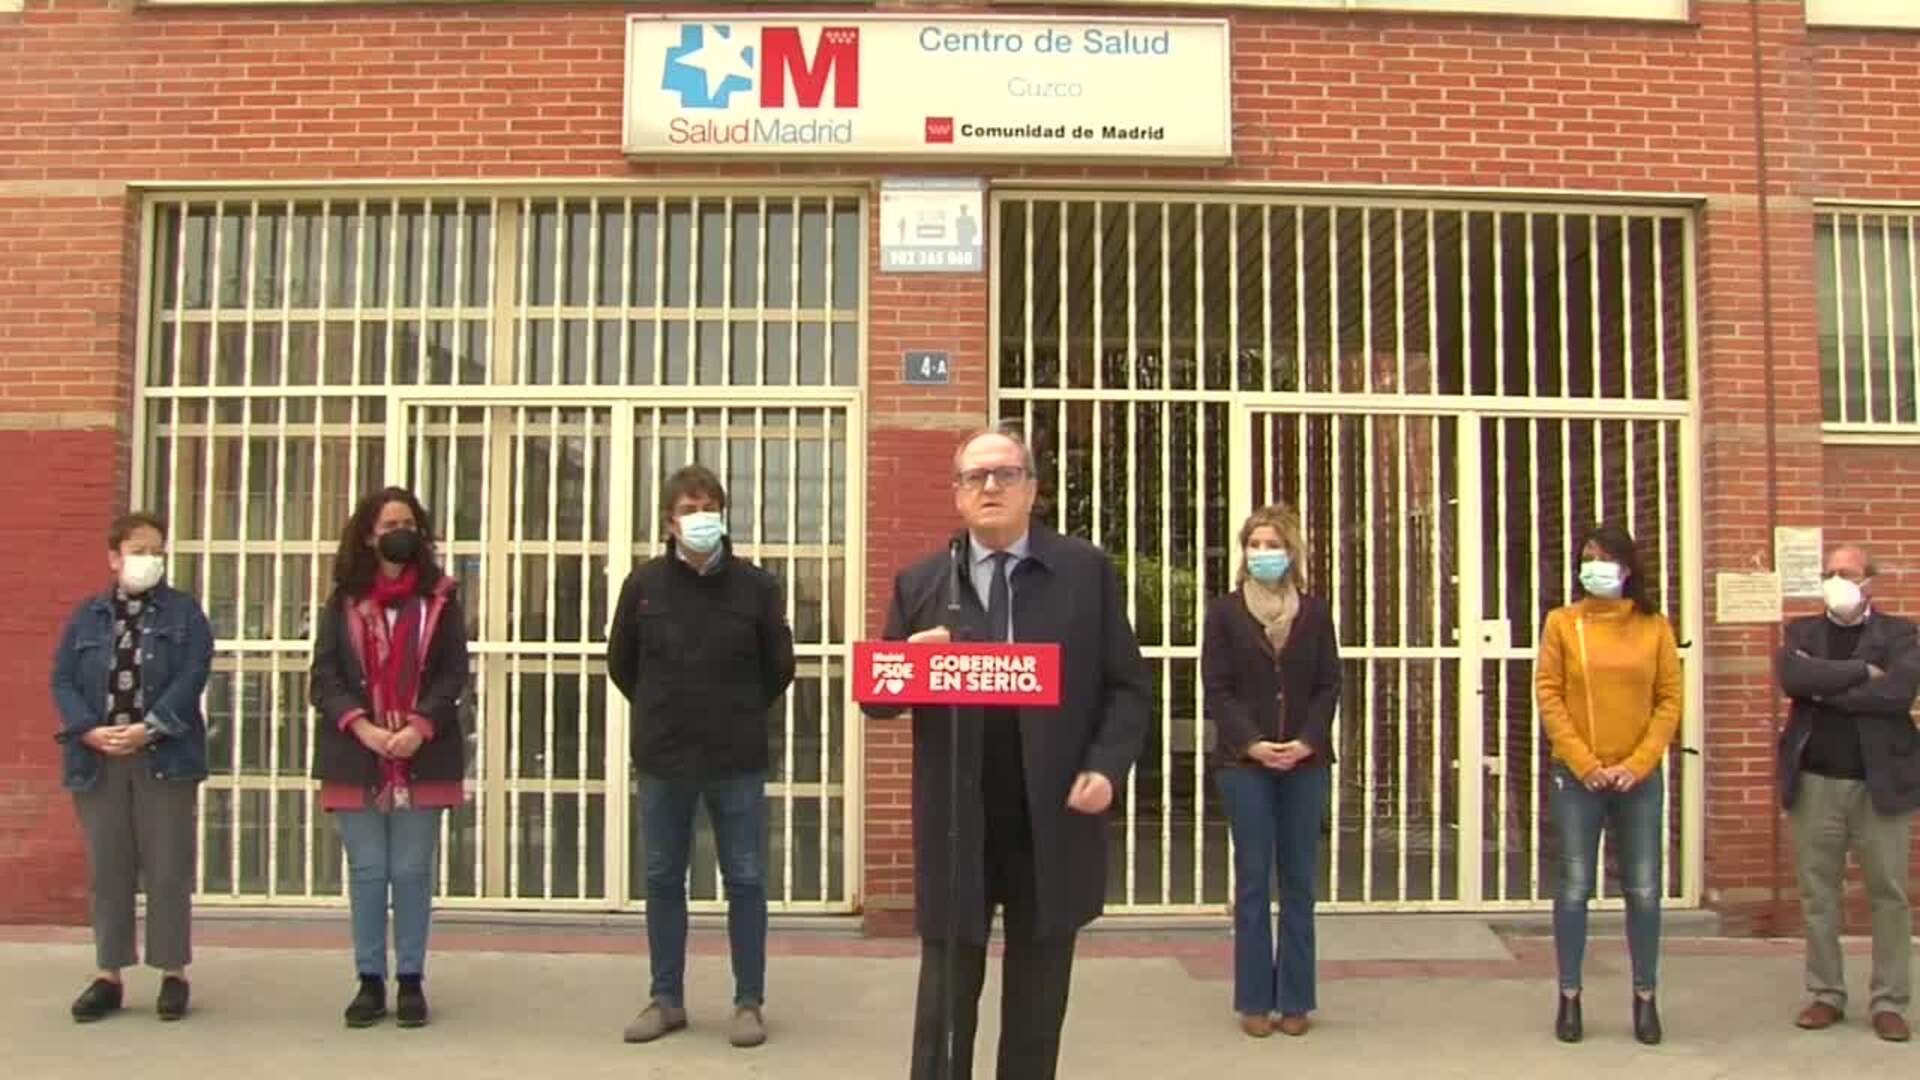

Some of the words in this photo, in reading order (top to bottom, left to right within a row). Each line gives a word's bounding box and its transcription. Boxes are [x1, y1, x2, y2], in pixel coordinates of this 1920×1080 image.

[919, 26, 1023, 53] Centro
[1034, 30, 1072, 53] de
[1083, 29, 1169, 55] Salud
[960, 123, 1065, 139] Comunidad
[1071, 126, 1094, 139] de
[1101, 126, 1165, 140] Madrid
[872, 663, 914, 679] PSOE
[929, 655, 1036, 673] GOBERNAR
[929, 672, 961, 692] EN
[966, 672, 1043, 692] SERIO.
